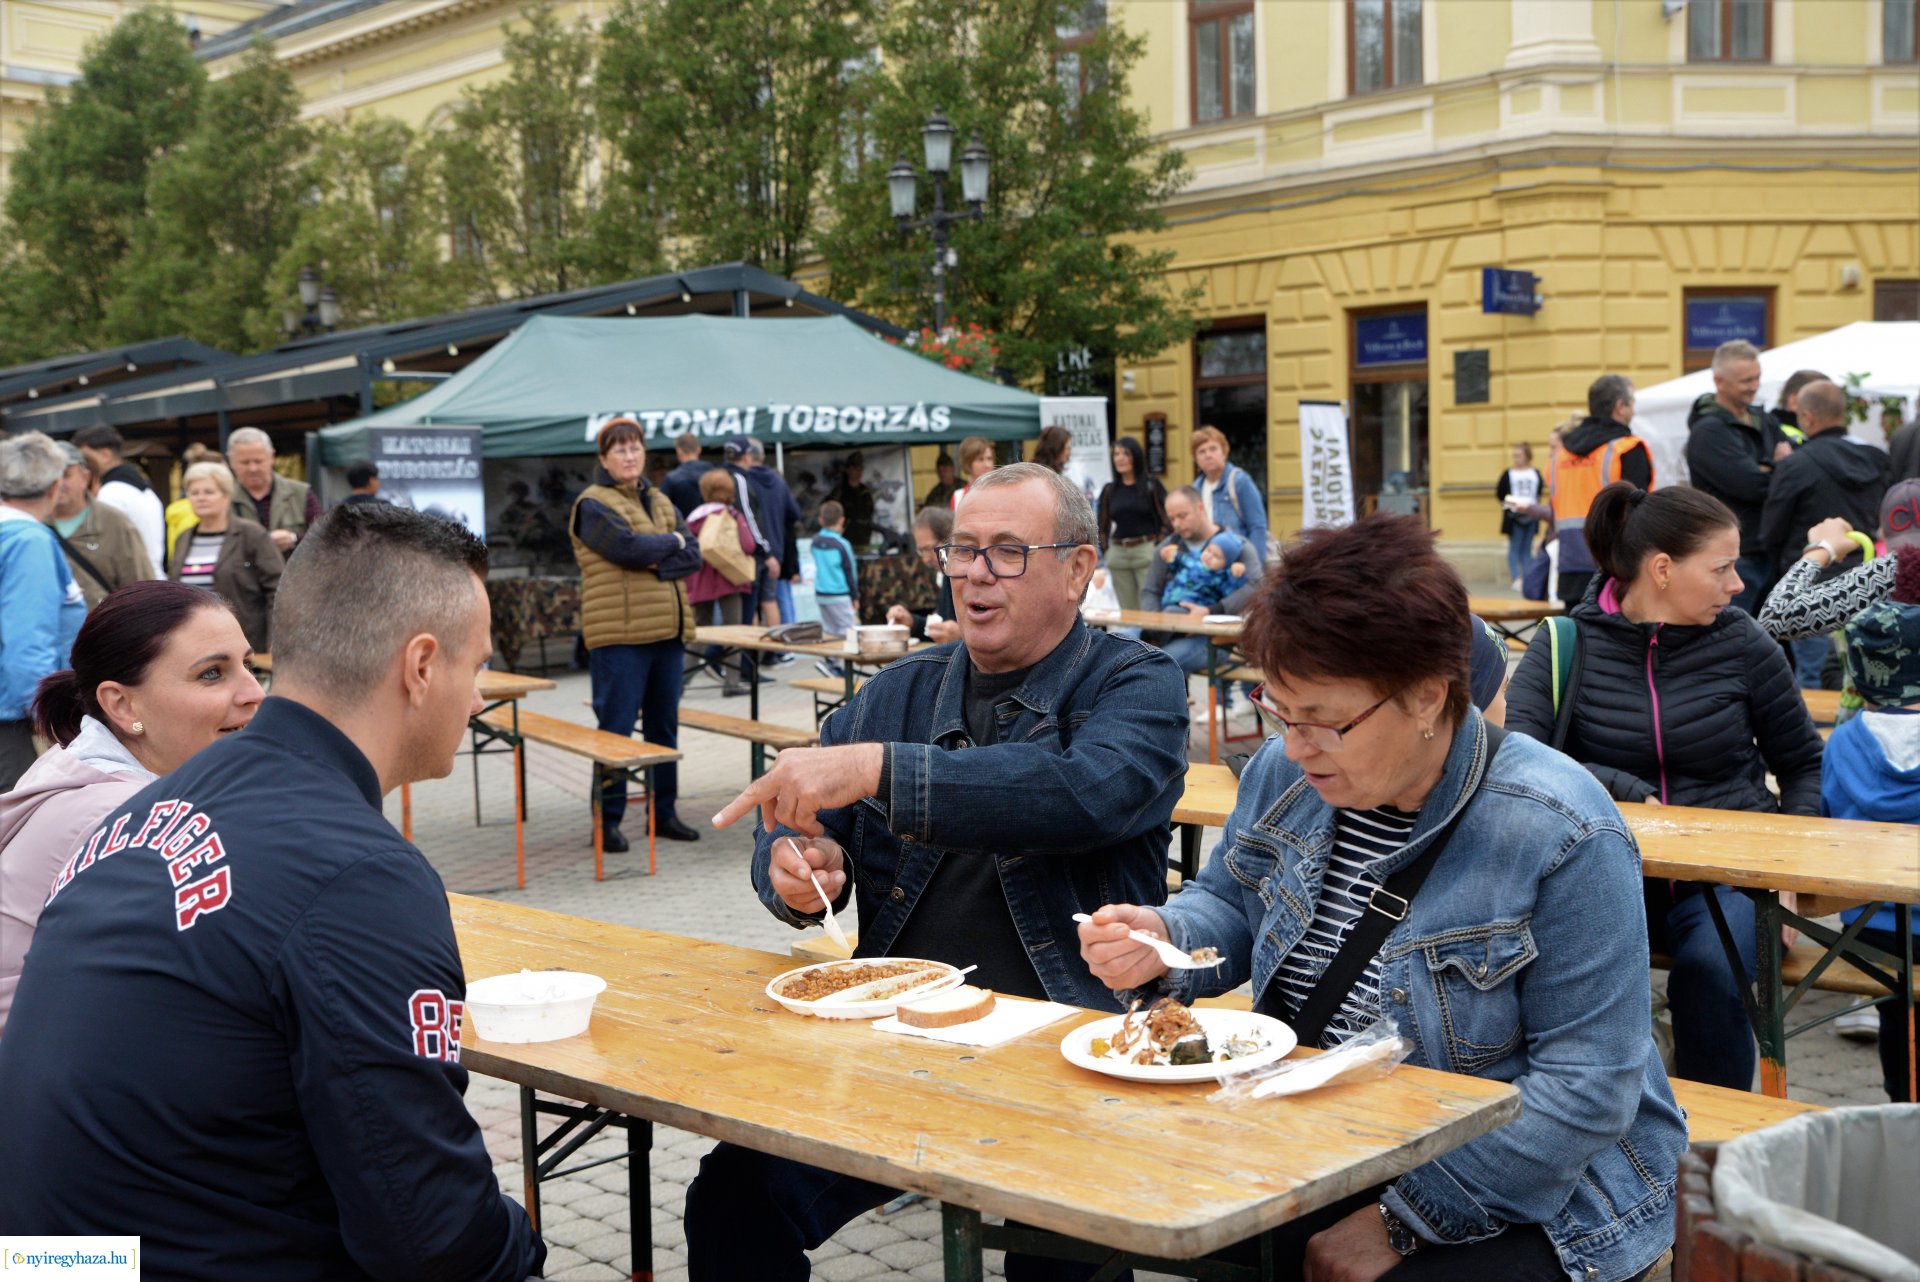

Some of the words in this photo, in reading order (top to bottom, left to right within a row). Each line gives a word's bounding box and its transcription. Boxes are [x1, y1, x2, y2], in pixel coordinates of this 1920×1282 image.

[768, 401, 951, 432] TOBORZÁS
[45, 799, 232, 931] HILFIGER
[408, 989, 465, 1063] 85
